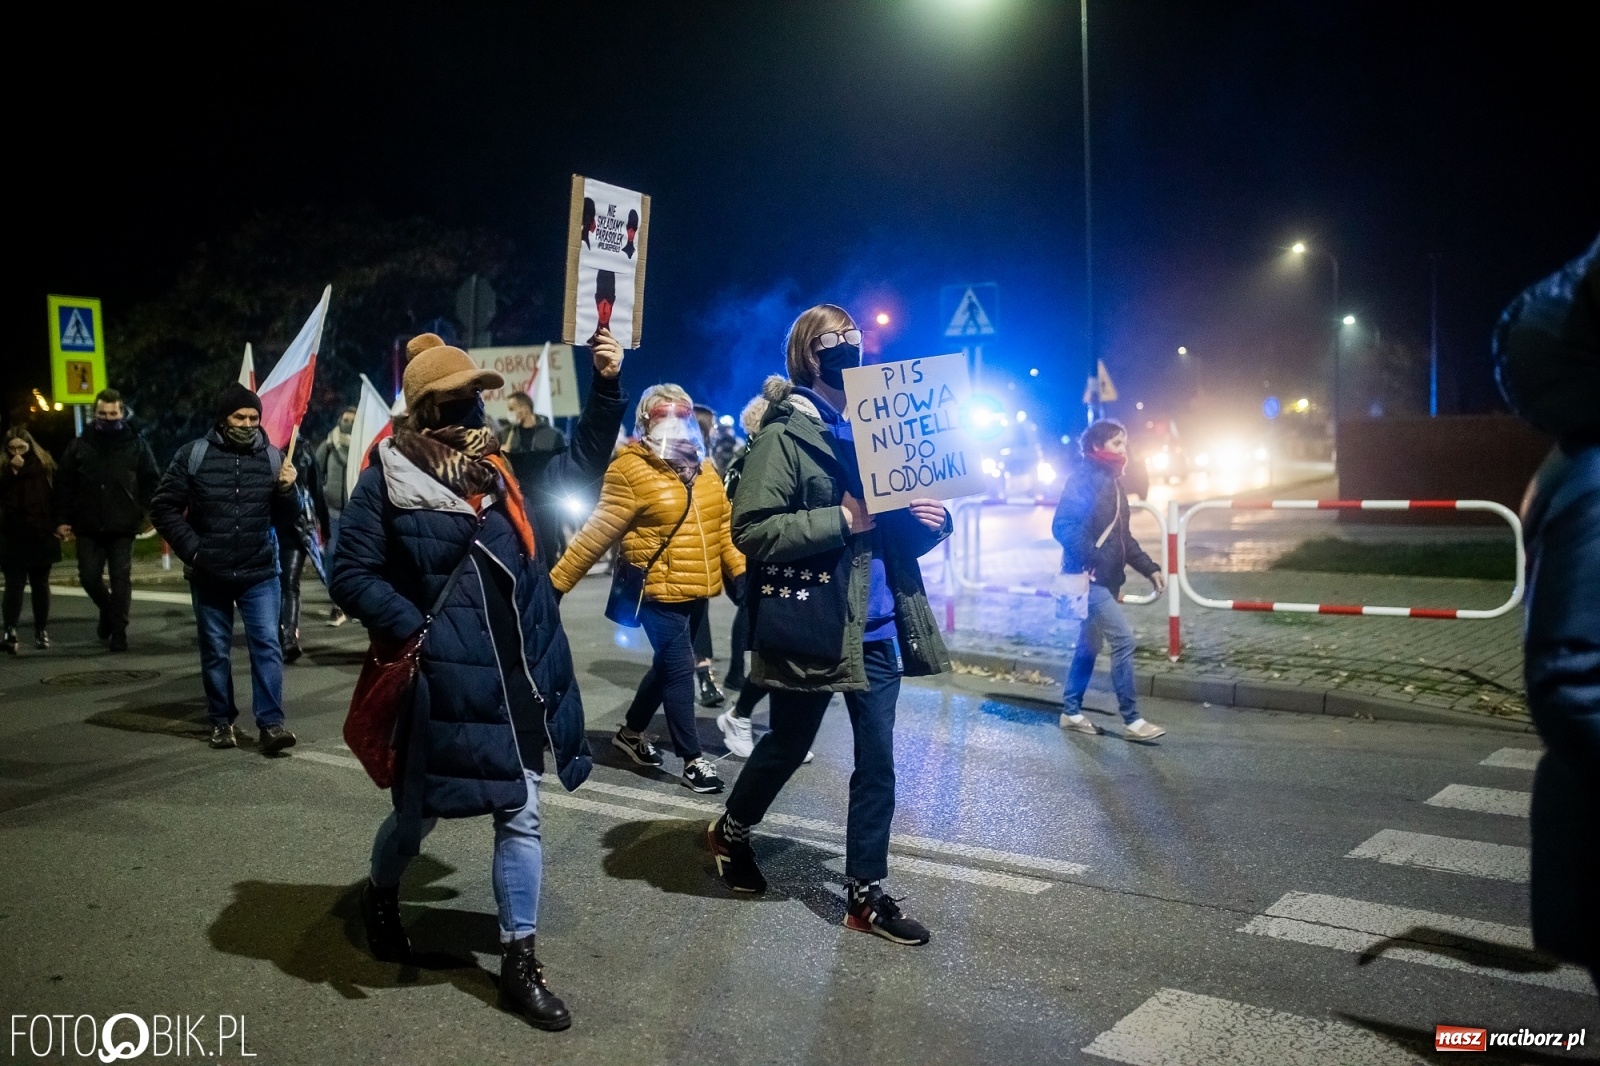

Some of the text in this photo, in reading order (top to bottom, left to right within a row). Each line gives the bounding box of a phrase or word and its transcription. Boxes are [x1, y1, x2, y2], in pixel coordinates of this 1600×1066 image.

[607, 204, 617, 217] NIE
[595, 228, 624, 246] PARASOLEK
[494, 351, 562, 374] OBROE
[881, 360, 924, 390] PIS
[857, 384, 958, 423] CHOWA
[871, 409, 960, 453] NUTELL
[903, 439, 936, 463] DO
